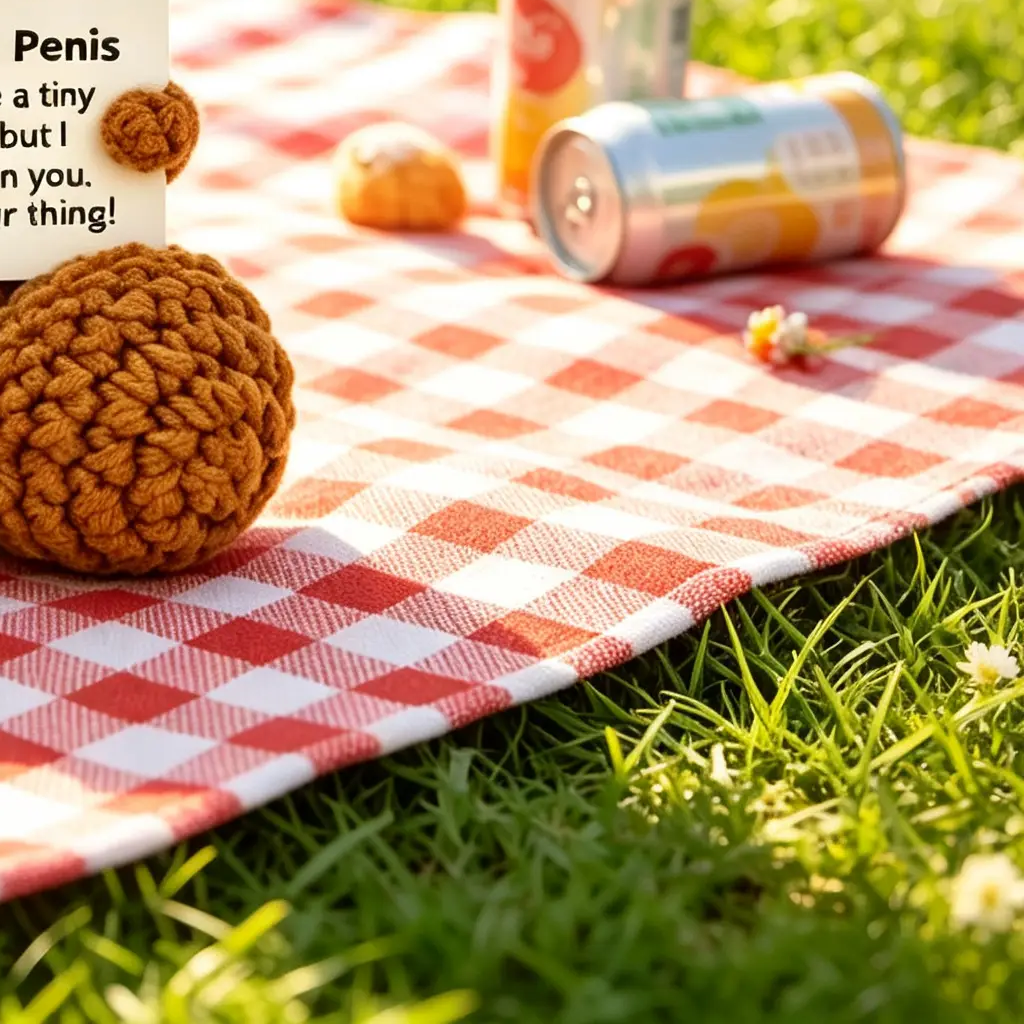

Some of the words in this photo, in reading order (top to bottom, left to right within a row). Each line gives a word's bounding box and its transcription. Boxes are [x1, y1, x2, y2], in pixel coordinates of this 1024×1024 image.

[14, 27, 120, 62] Penis
[12, 88, 30, 109] a
[38, 82, 96, 115] tiny
[0, 120, 52, 149] but
[60, 120, 67, 147] I
[27, 168, 92, 197] you.
[27, 196, 116, 234] thing!
